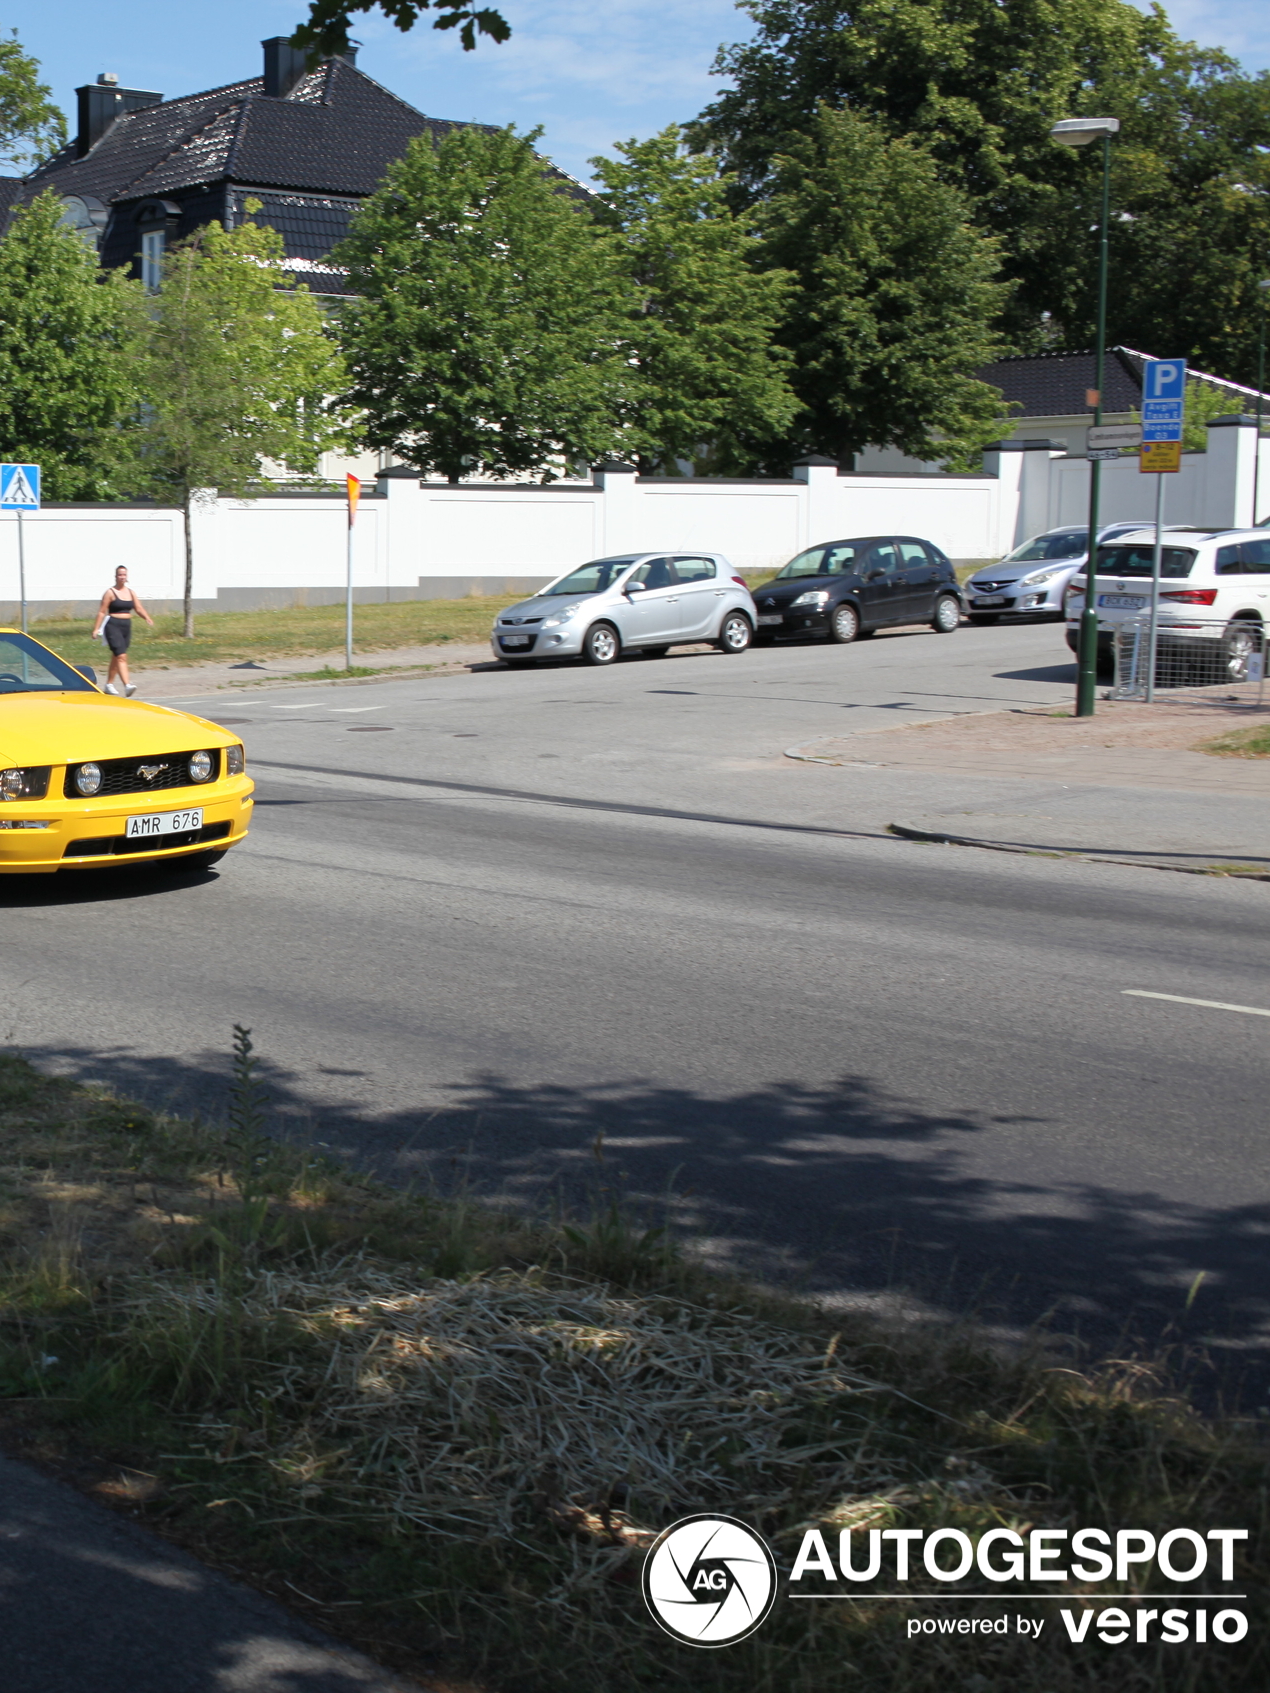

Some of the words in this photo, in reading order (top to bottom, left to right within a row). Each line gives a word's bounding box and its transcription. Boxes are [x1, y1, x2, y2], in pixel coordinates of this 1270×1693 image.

[1153, 364, 1178, 396] P
[1148, 402, 1178, 412] Avgift
[1146, 411, 1170, 419] Taxa
[1143, 423, 1179, 431] Boende
[131, 817, 161, 835] AMR
[172, 811, 199, 830] 676
